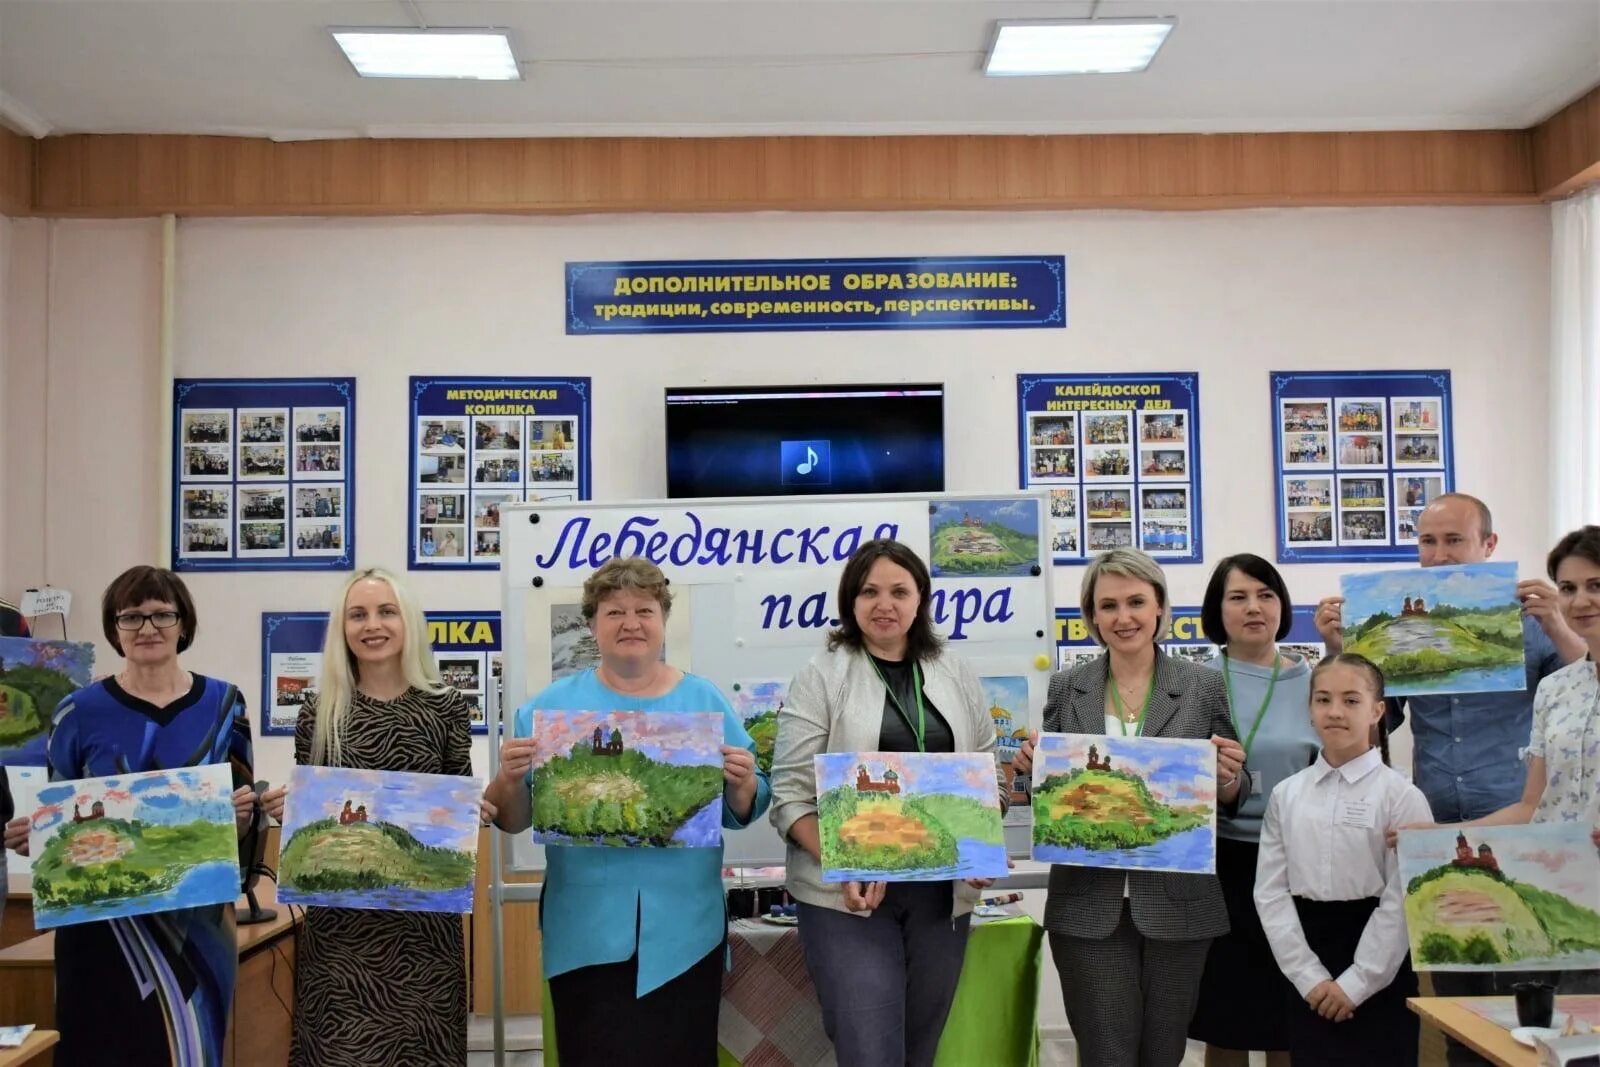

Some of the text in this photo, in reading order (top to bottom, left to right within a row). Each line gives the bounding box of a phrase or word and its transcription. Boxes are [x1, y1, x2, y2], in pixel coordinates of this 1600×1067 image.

[613, 272, 1018, 296] ДОПОЛНИТЕЛЬНОЕ ОБРАЗОВАНИЕ:
[593, 299, 1036, 321] традиции, современность, перспективы.
[446, 389, 558, 401] МЕТОДИЧЕСКАЯ
[1055, 383, 1161, 397] КАЛЕЙДОСКОП
[464, 404, 536, 415] КОПИЛКА
[1046, 399, 1172, 411] ИНТЕРЕСНЫХ ДЕЛ
